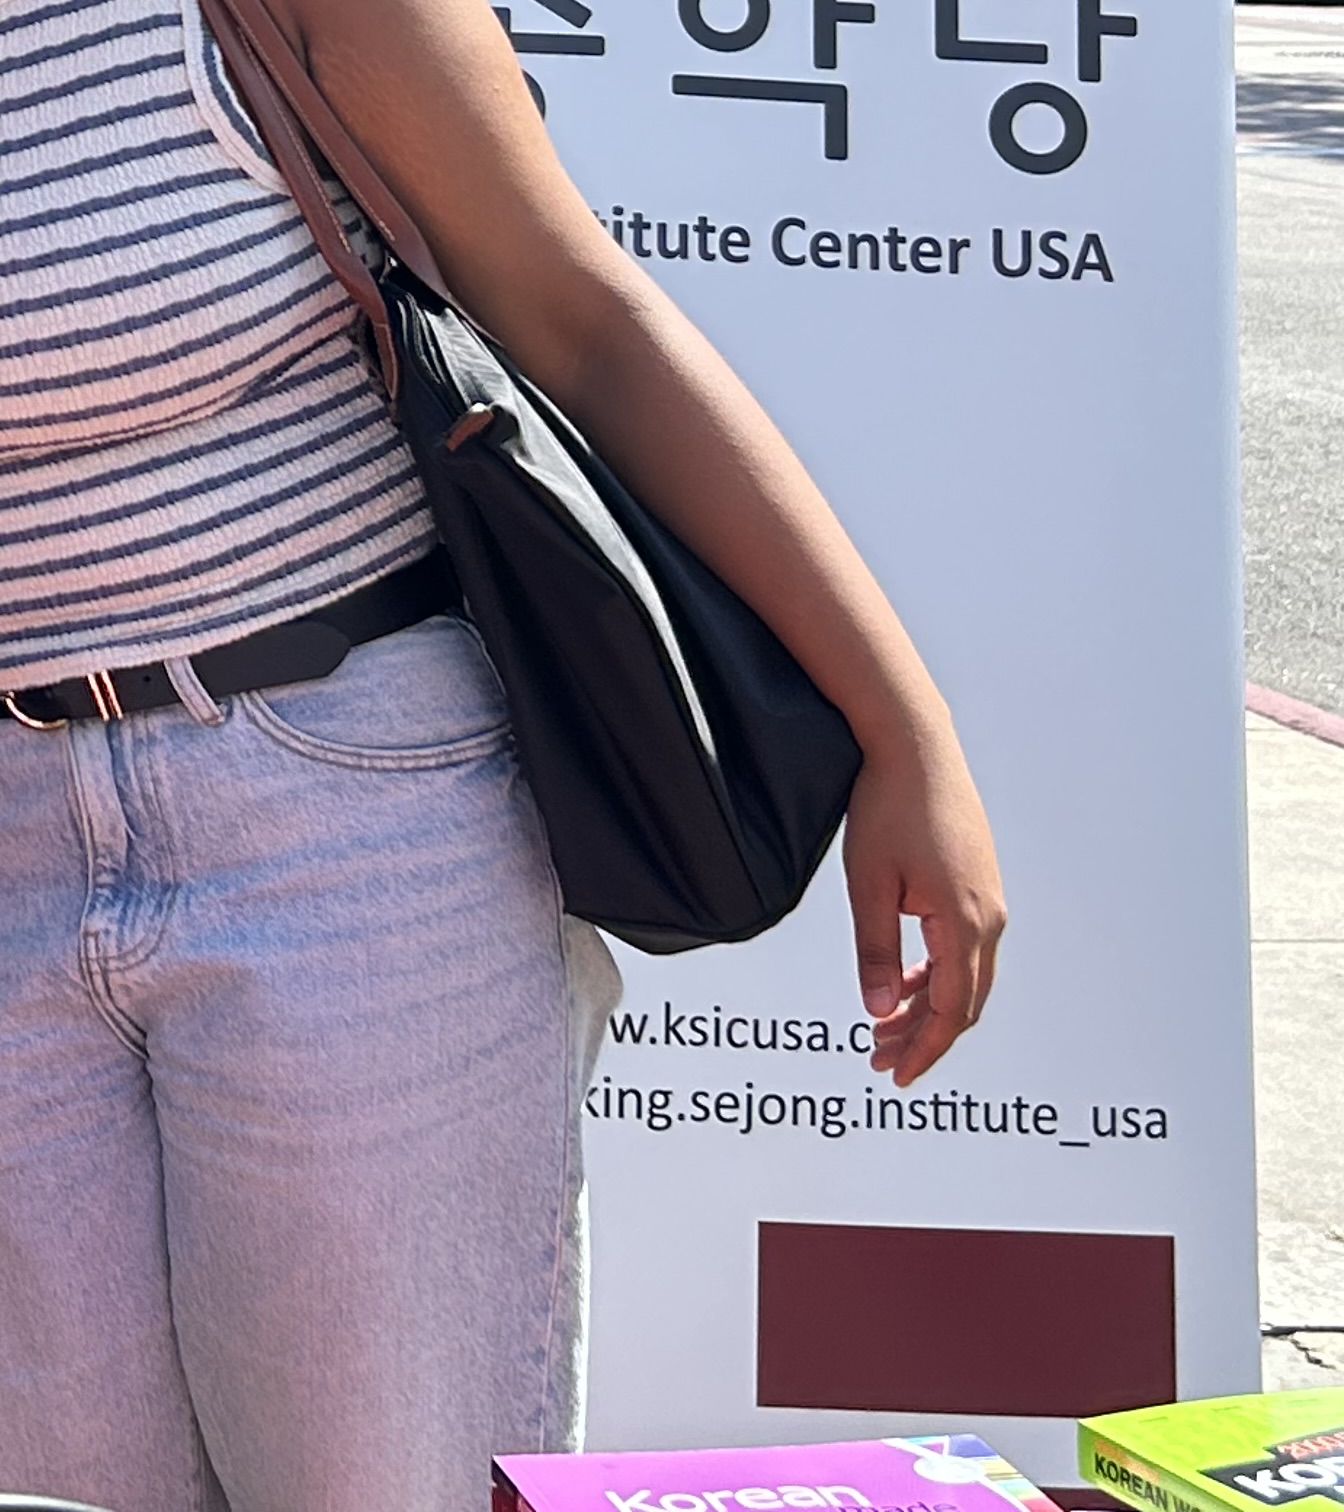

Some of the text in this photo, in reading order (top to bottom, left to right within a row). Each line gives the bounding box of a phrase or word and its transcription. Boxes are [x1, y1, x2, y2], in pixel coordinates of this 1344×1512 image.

[592, 205, 1115, 284] itute Center USA
[609, 1000, 872, 1054] w.ksicusa.c
[604, 1484, 872, 1512] Korean
[1094, 1452, 1169, 1511] KOREAN
